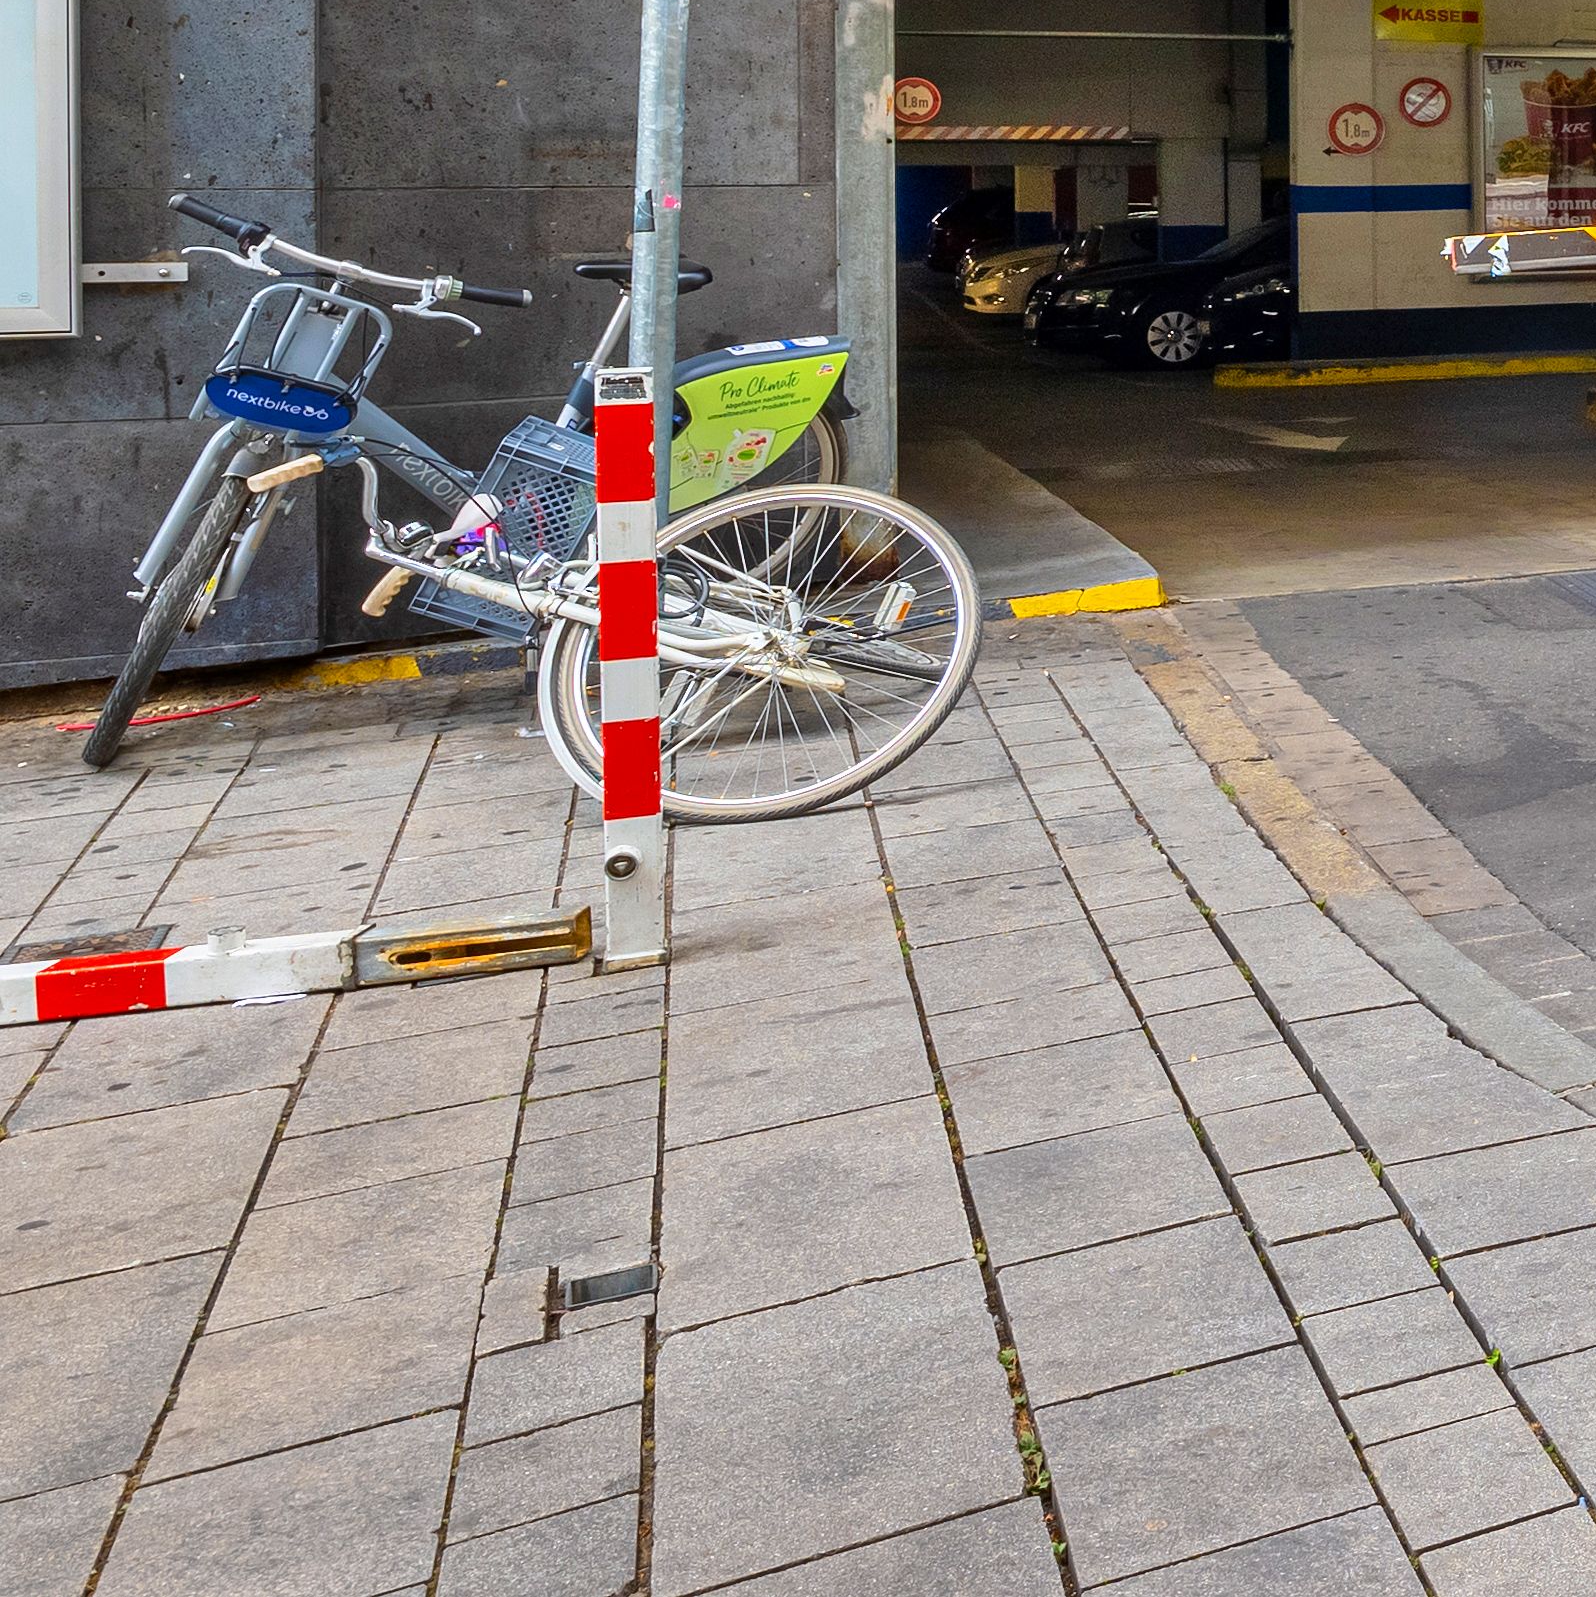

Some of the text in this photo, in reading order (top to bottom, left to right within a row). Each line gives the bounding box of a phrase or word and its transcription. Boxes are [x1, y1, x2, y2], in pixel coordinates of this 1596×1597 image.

[1401, 8, 1460, 22] KASSE
[1504, 59, 1527, 69] KFC
[1561, 121, 1590, 133] KFC
[1491, 197, 1531, 211] Hier
[1493, 212, 1592, 227] Sie auf den
[720, 371, 800, 402] Pro Climate
[226, 388, 302, 414] nextbike
